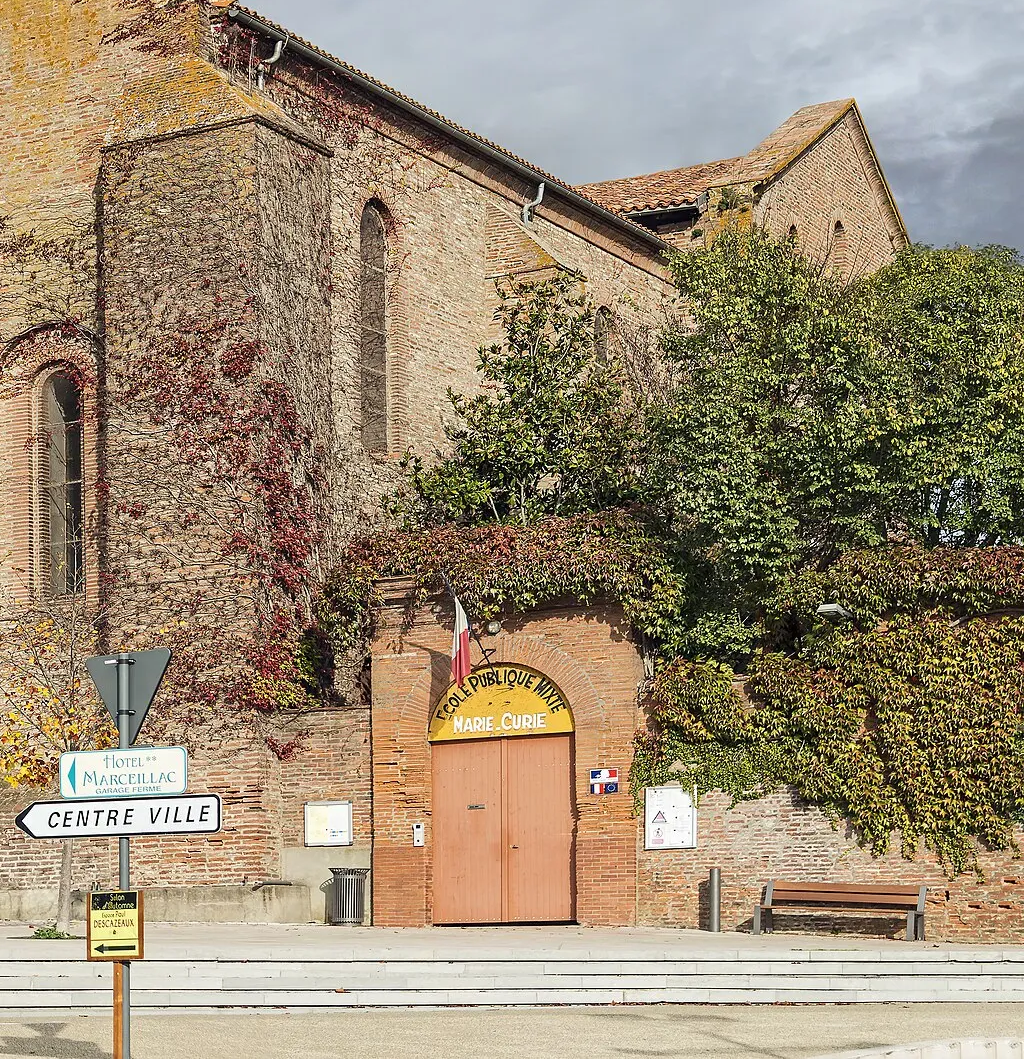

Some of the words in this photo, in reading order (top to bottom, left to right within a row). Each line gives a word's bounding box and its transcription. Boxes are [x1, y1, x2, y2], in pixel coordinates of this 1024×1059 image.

[436, 684, 473, 720] ECOLE
[467, 669, 537, 692] PUBLIQUE
[533, 677, 567, 714] MIXTE
[103, 754, 145, 769] HOTEL
[82, 770, 177, 787] MARCEILLAC
[95, 786, 130, 795] GARAGE
[48, 808, 135, 828] CENTRE
[149, 805, 211, 824] VILLE
[94, 918, 135, 928] DESCAZEAUX
